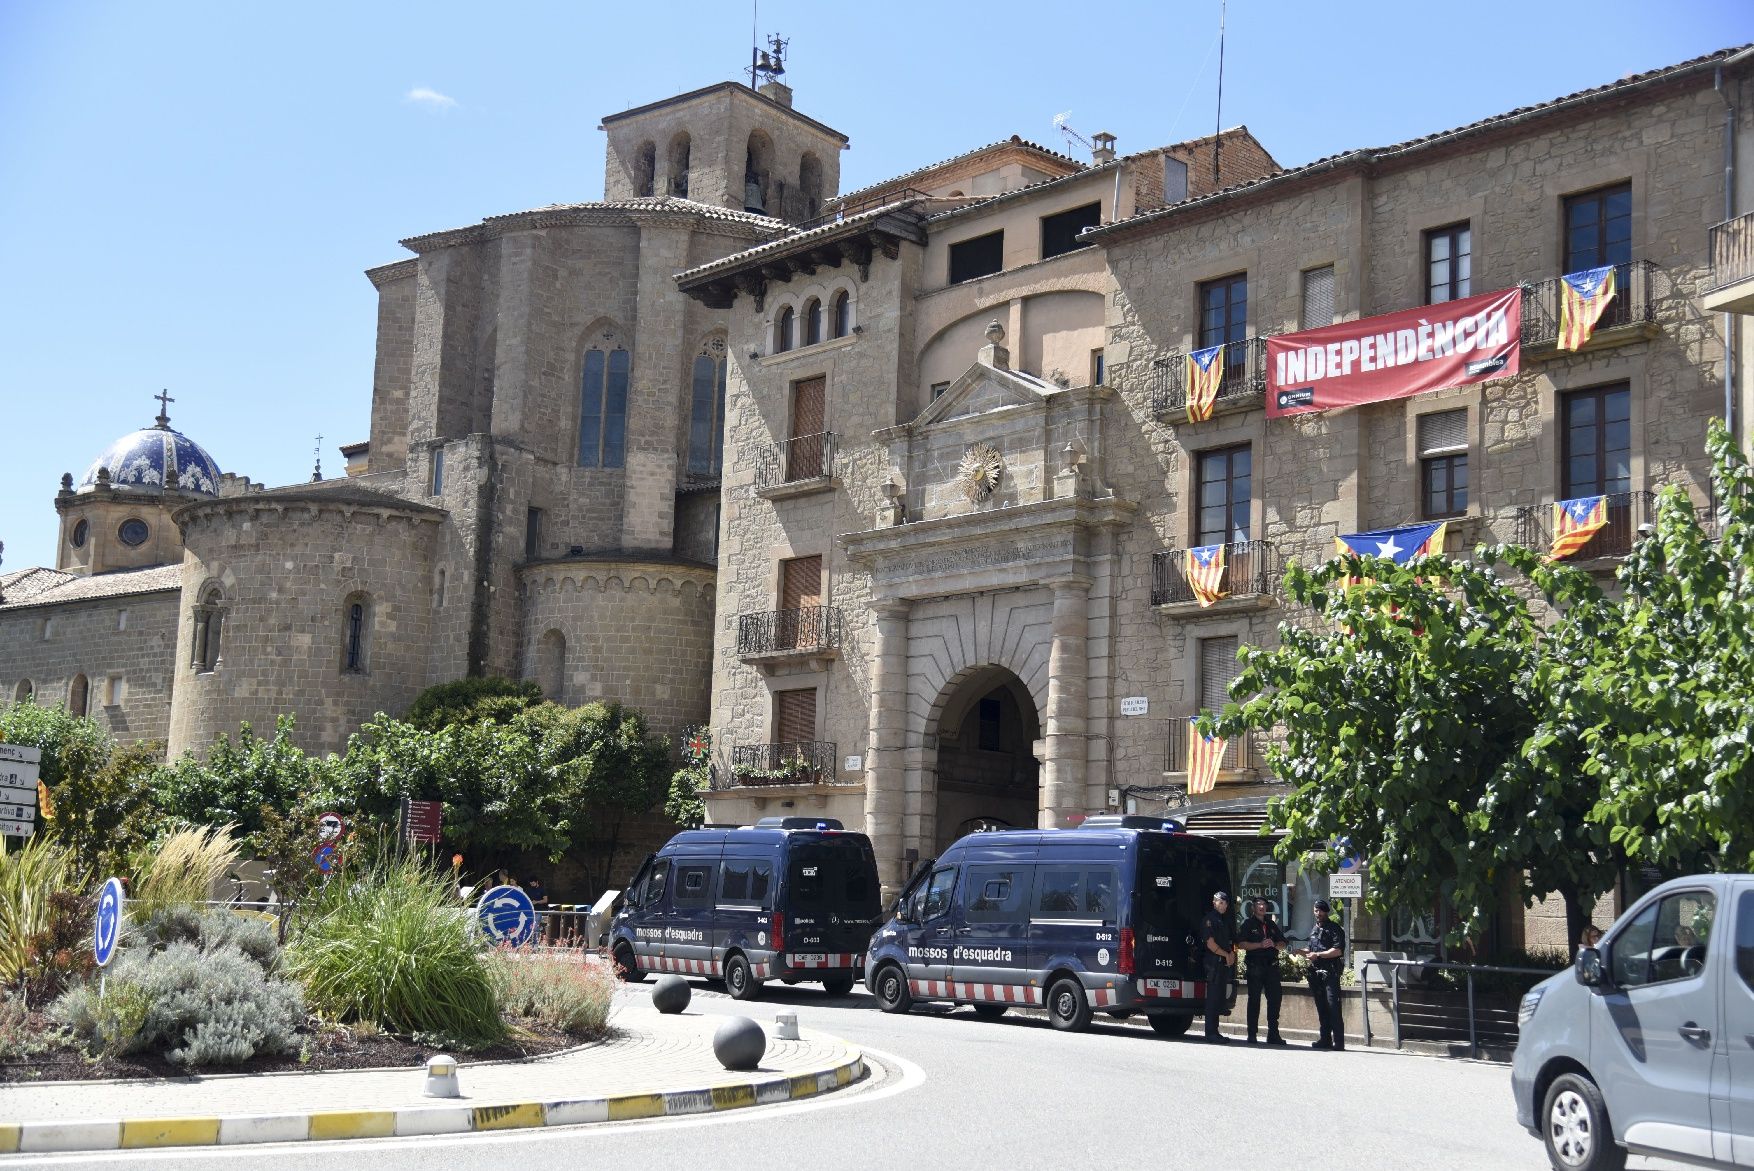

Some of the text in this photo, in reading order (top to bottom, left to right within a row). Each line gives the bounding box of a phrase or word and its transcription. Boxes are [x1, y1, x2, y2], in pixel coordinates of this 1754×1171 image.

[1276, 310, 1508, 386] INDEPENDÈNCIA
[1241, 883, 1279, 900] pou de
[636, 926, 703, 942] mossos d'esquadra
[1096, 932, 1112, 941] D-512
[1152, 935, 1169, 943] policia
[908, 946, 1012, 963] mossos d'esquadra
[1155, 958, 1173, 967] D-512
